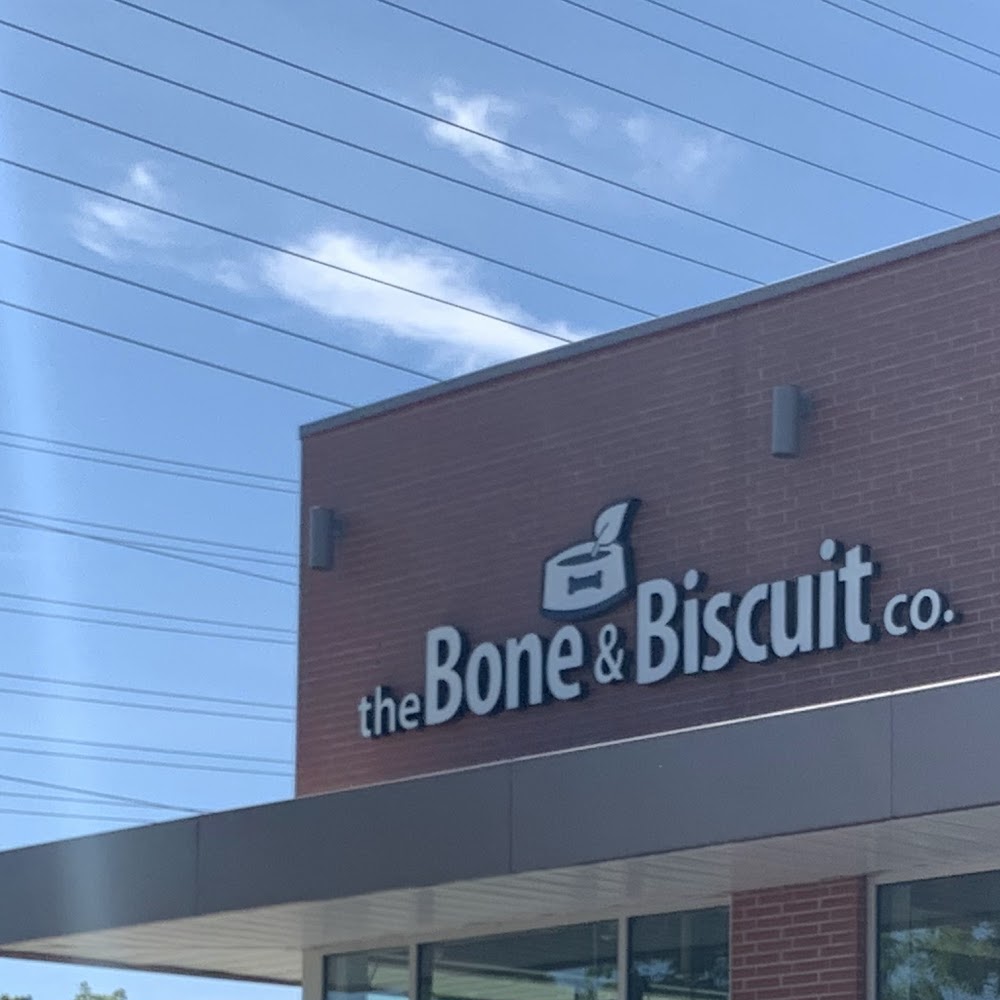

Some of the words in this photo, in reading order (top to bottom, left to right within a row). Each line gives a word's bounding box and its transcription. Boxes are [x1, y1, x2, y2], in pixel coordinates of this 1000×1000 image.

[357, 685, 420, 739] the
[423, 624, 586, 726] Bone
[592, 622, 626, 684] &
[635, 537, 875, 686] Biscuit
[882, 587, 955, 637] co.
